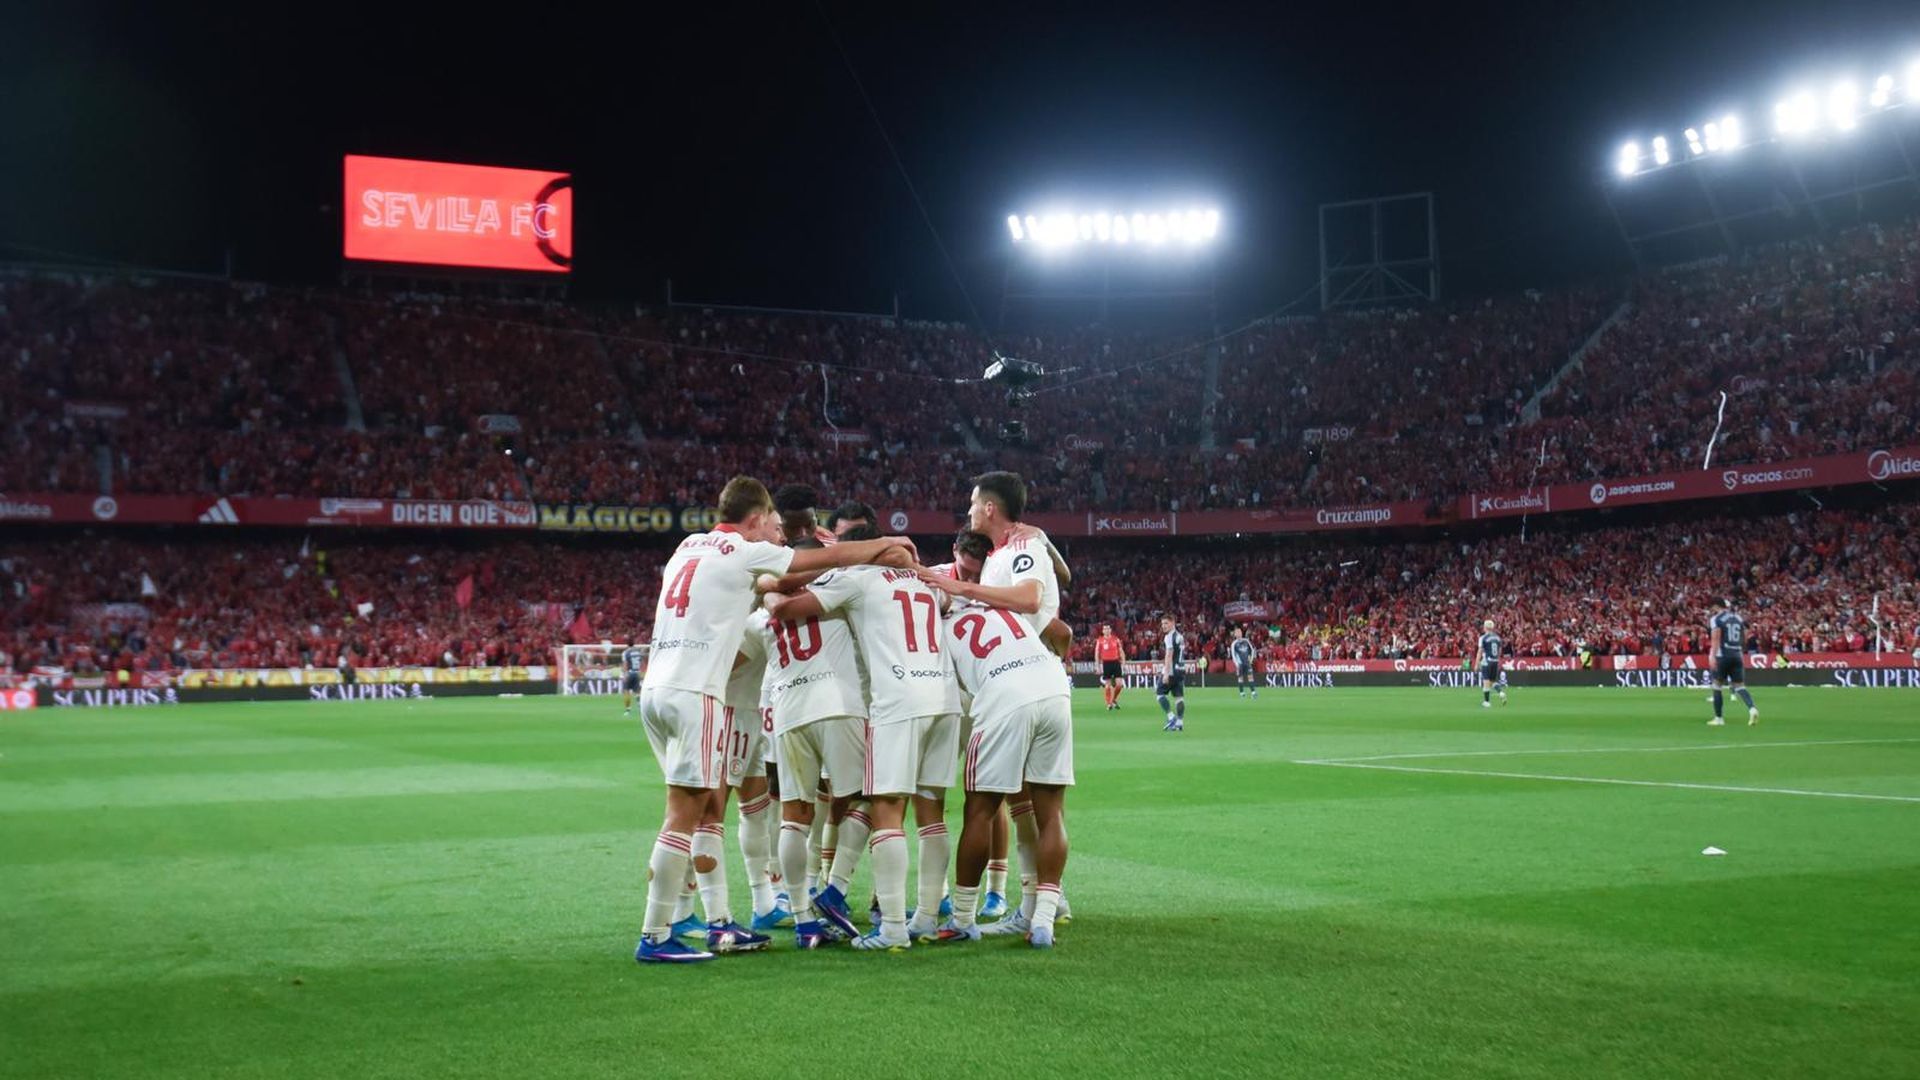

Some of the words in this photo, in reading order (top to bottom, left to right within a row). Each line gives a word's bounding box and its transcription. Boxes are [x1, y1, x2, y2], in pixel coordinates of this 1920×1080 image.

[362, 189, 502, 234] SEVILLA
[510, 203, 557, 239] FC
[1873, 455, 1920, 477] Mide
[1494, 493, 1544, 510] CaixaBank
[392, 503, 452, 522] DICEN
[459, 504, 498, 523] QUE
[1316, 507, 1391, 525] Cruzcampo
[1111, 517, 1168, 529] CaixaBank
[664, 558, 701, 618] 4
[893, 590, 939, 653] 17
[953, 607, 1026, 660] 21
[1726, 623, 1741, 642] 16
[766, 616, 822, 669] 10
[1491, 642, 1498, 657] 8
[1265, 672, 1322, 688] SCALPERS
[1429, 671, 1484, 687] SCALPE
[1616, 669, 1697, 688] SCALPERS
[1834, 669, 1920, 687] SCALPER
[52, 688, 160, 707] SCALPERS
[309, 684, 407, 701] SCALPERS
[564, 680, 626, 697] SCALP
[761, 707, 774, 732] 8
[733, 730, 749, 759] 11
